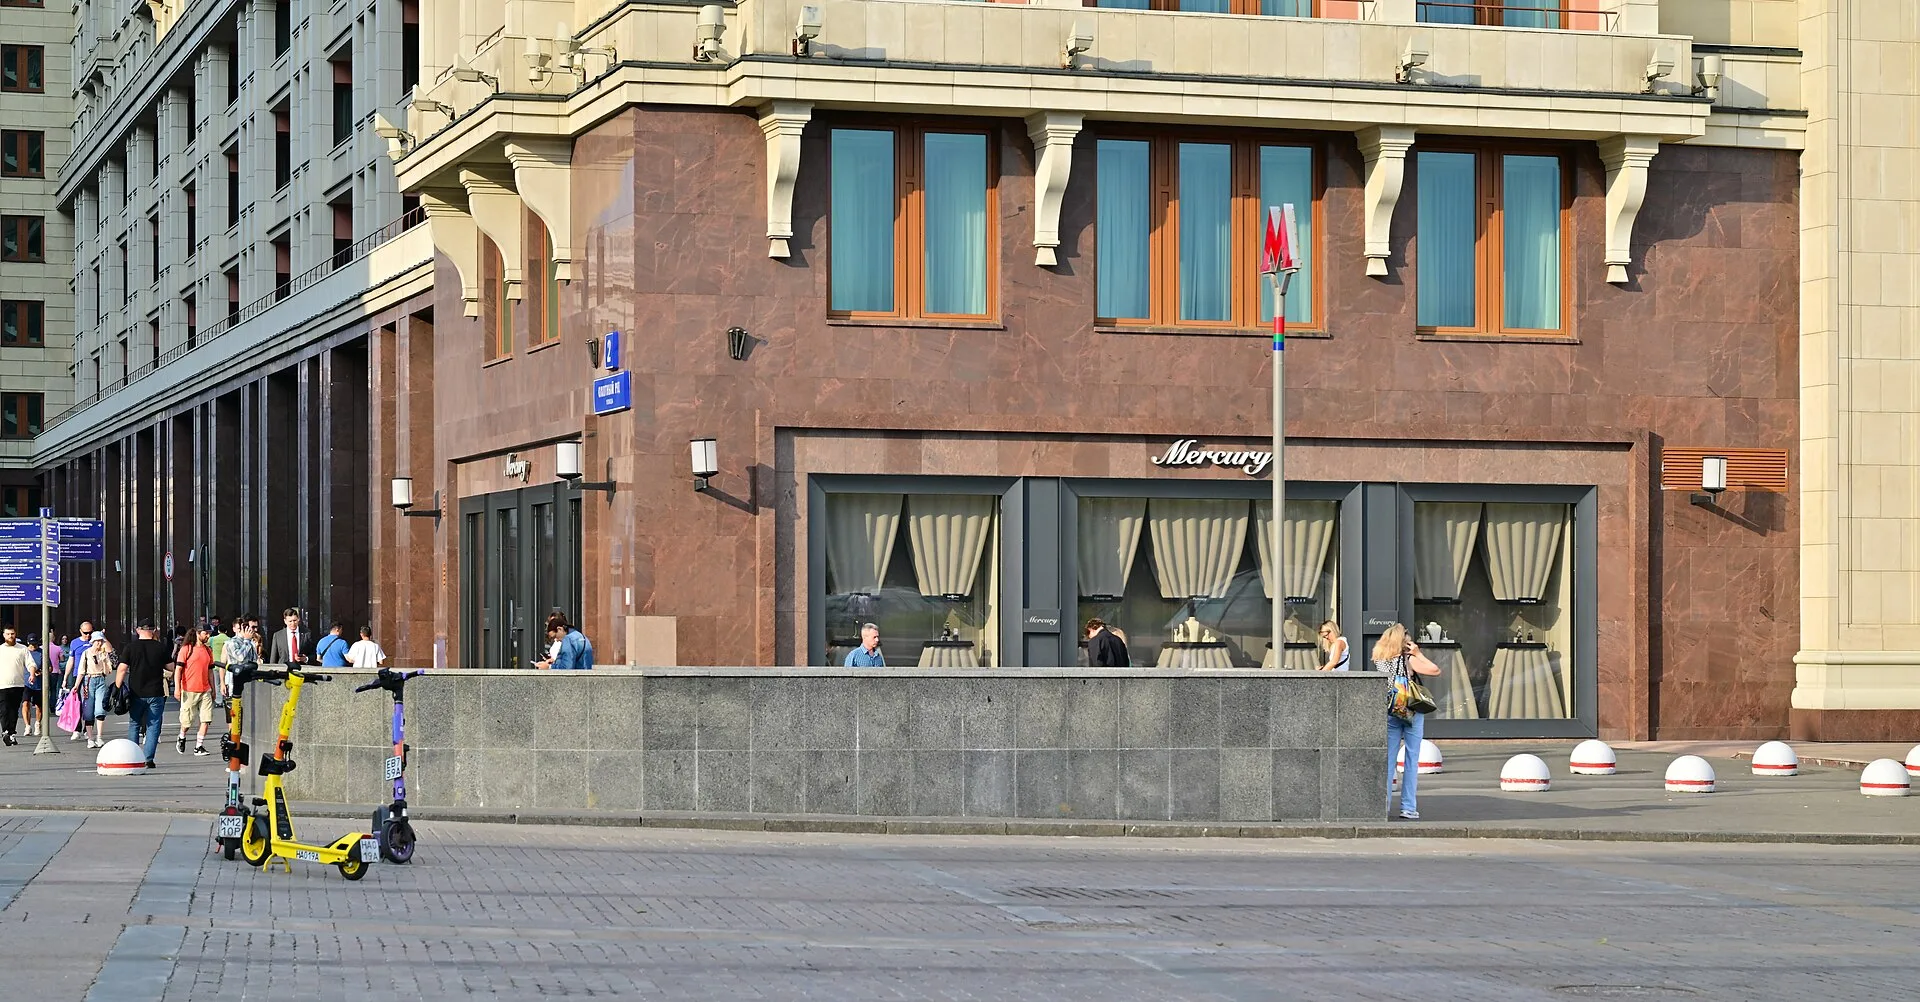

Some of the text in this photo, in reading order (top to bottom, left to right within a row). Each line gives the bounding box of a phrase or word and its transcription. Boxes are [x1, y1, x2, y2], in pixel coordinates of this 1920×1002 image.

[606, 339, 612, 362] 2
[1150, 439, 1273, 475] Mercury
[1024, 615, 1058, 626] Mercury
[1364, 618, 1396, 627] Mercury
[386, 757, 401, 769] EB7
[386, 767, 401, 779] 59A
[220, 817, 241, 826] KM2
[221, 827, 241, 836] 10P
[363, 851, 379, 861] 19A
